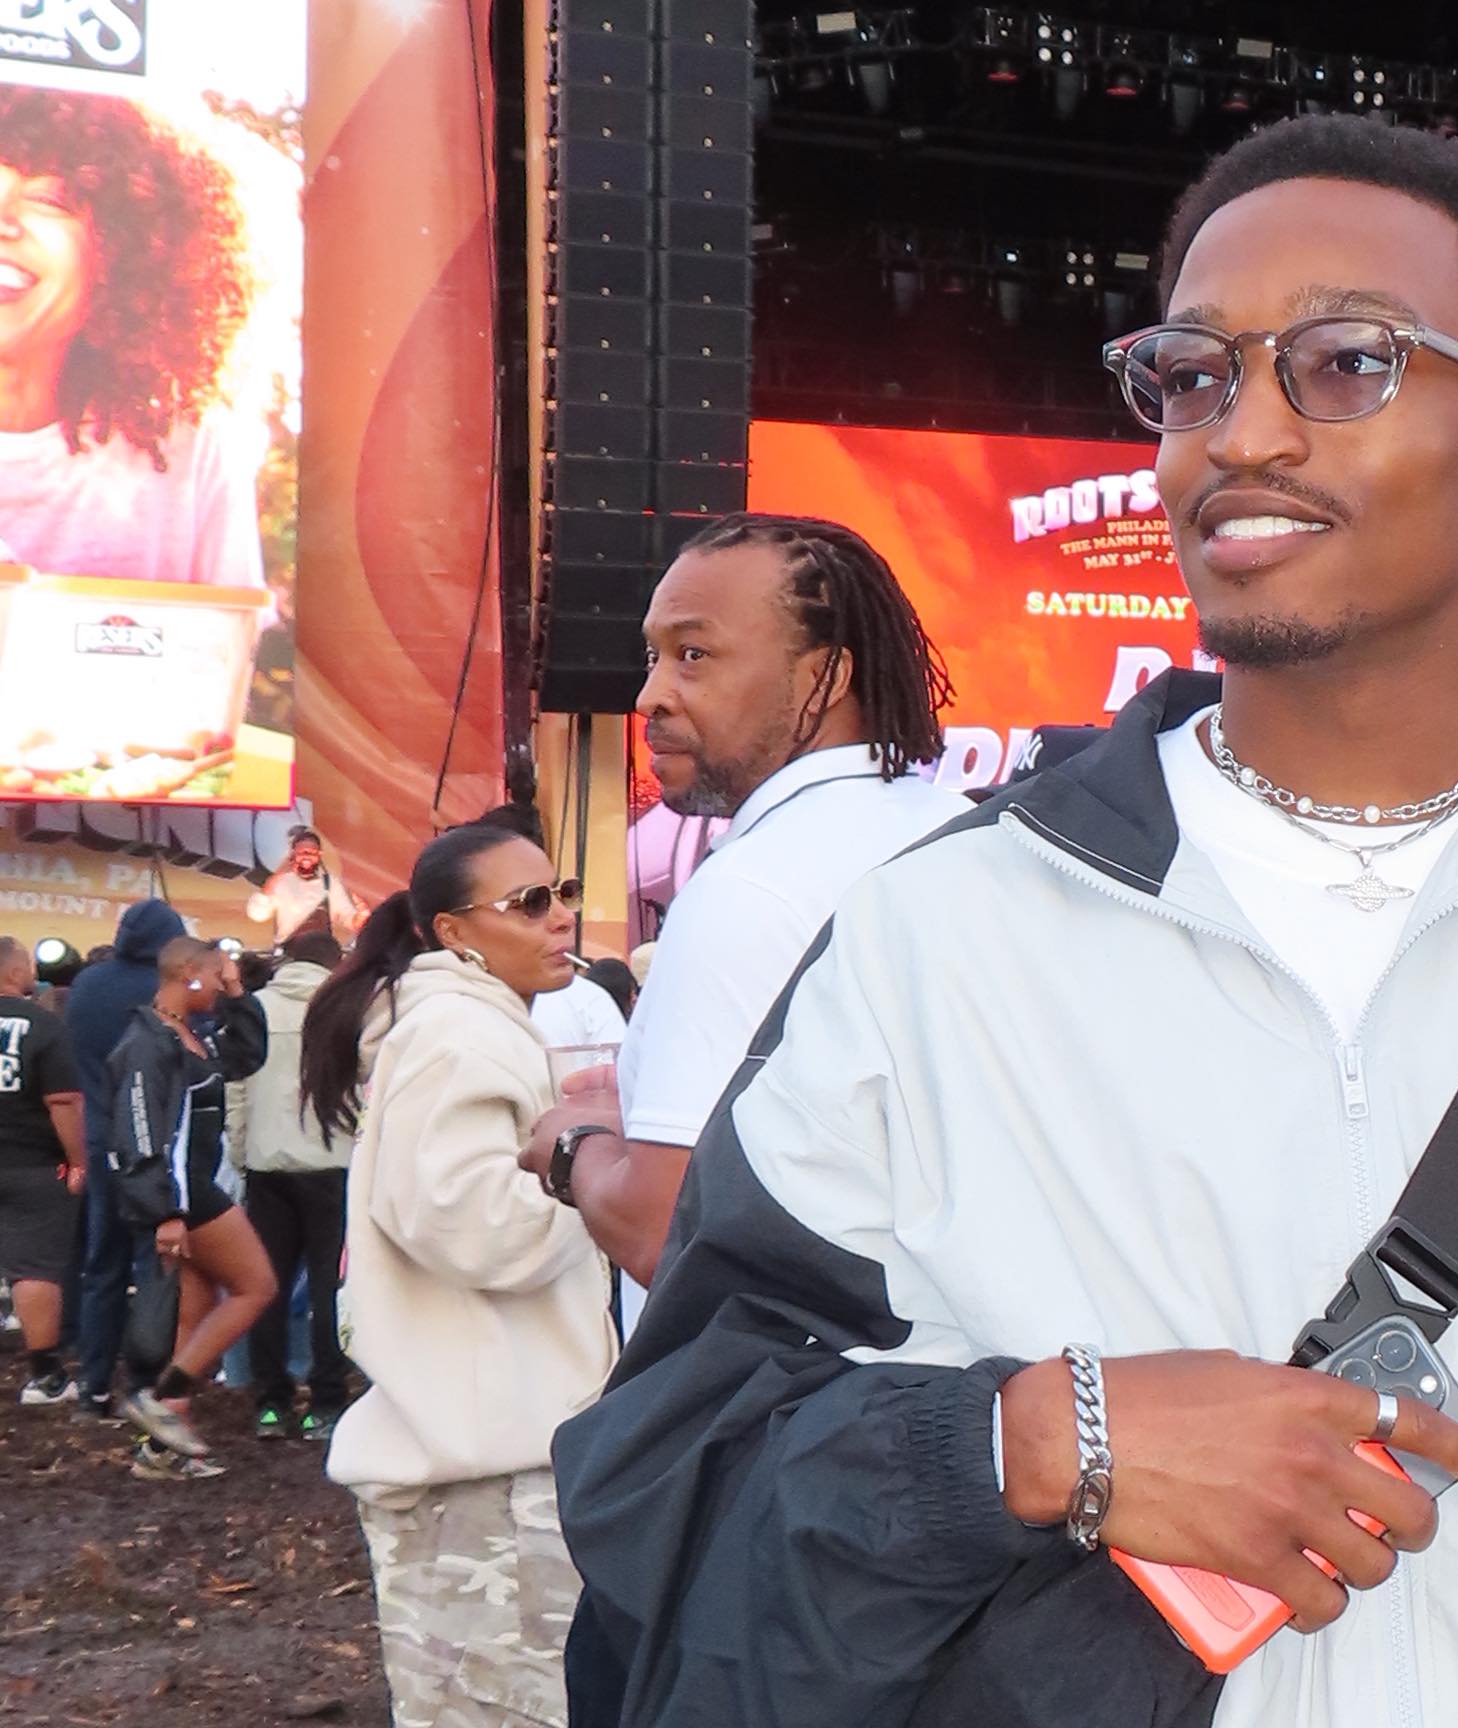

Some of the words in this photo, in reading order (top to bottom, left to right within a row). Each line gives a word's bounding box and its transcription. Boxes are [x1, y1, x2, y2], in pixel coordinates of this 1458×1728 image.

[1010, 469, 1160, 543] ROOTS
[1060, 538, 1092, 555] THE
[1092, 534, 1139, 550] MANN
[1141, 533, 1159, 546] IN
[1083, 553, 1120, 570] MAY
[1026, 591, 1193, 621] SATURDAY
